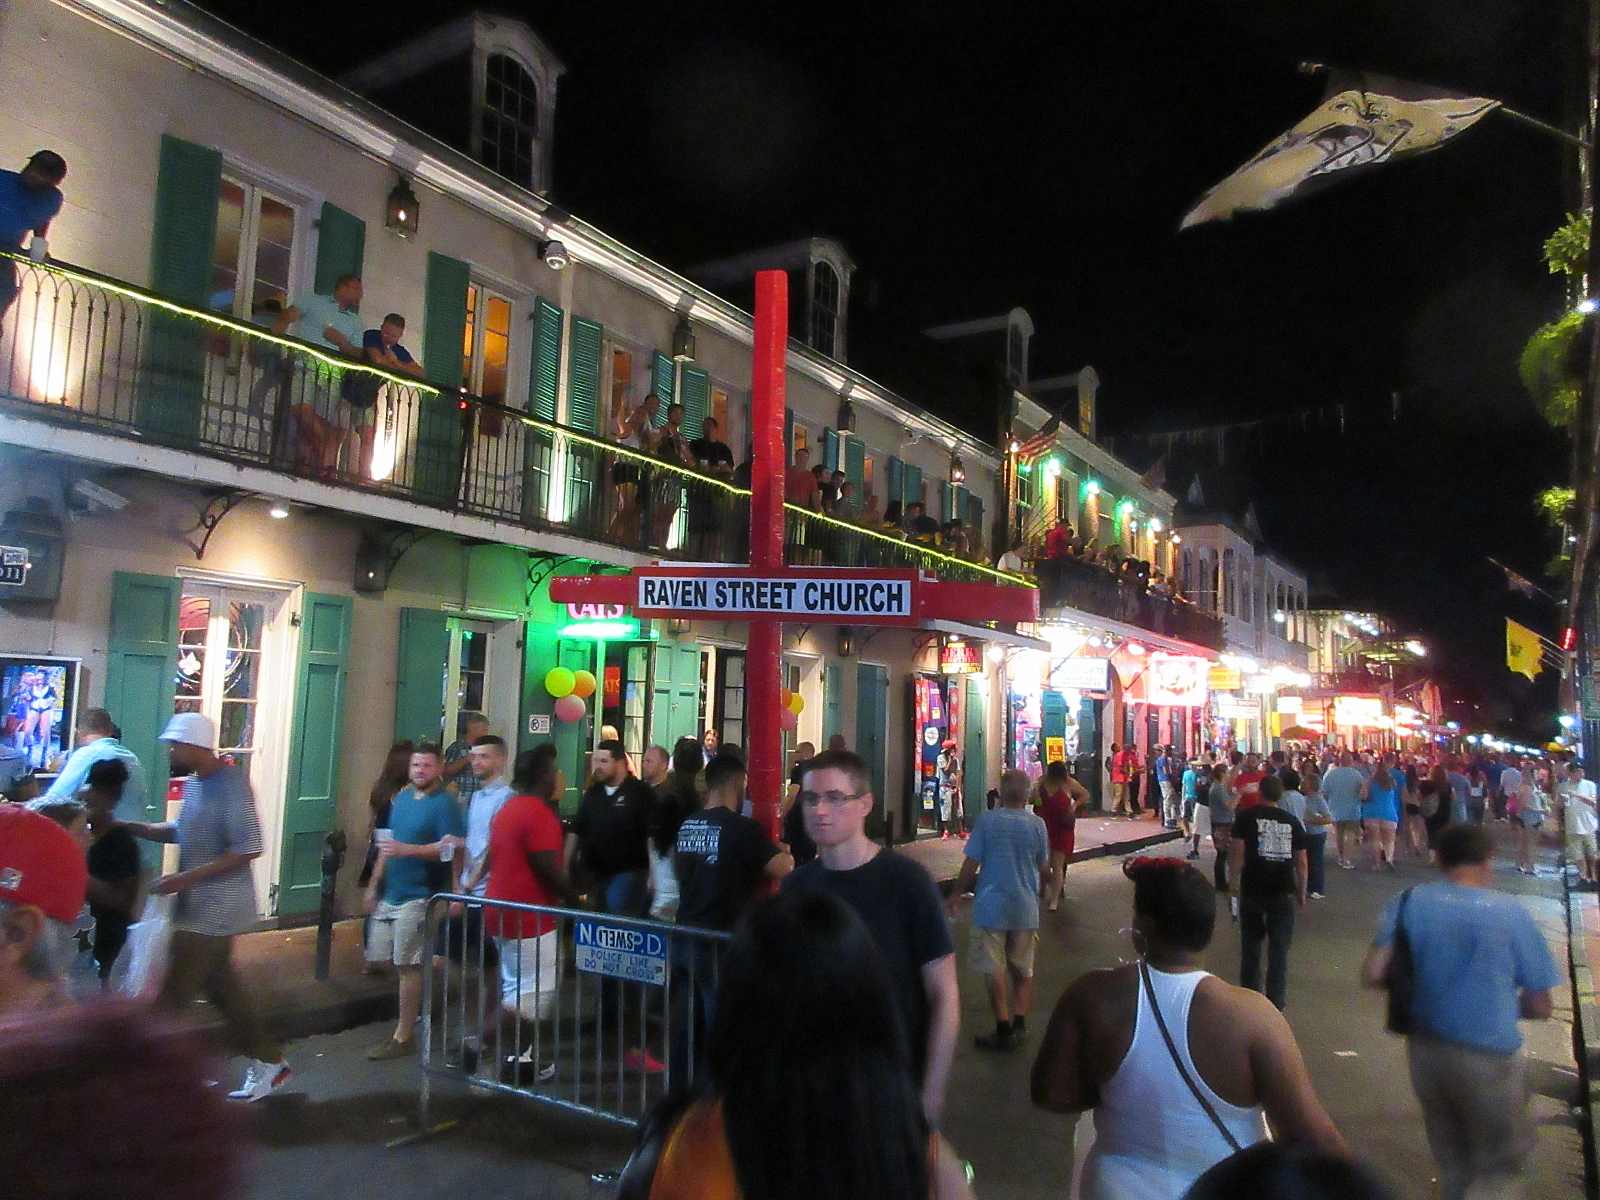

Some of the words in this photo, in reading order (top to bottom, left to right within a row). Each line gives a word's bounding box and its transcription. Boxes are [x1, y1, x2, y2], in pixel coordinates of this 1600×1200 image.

[643, 579, 707, 608] RAVEN
[714, 580, 796, 610] STREET
[803, 581, 903, 613] CHURCH
[584, 957, 597, 969] DO
[602, 961, 620, 973] NOT
[590, 948, 622, 964] POLICE
[629, 955, 649, 969] LINE
